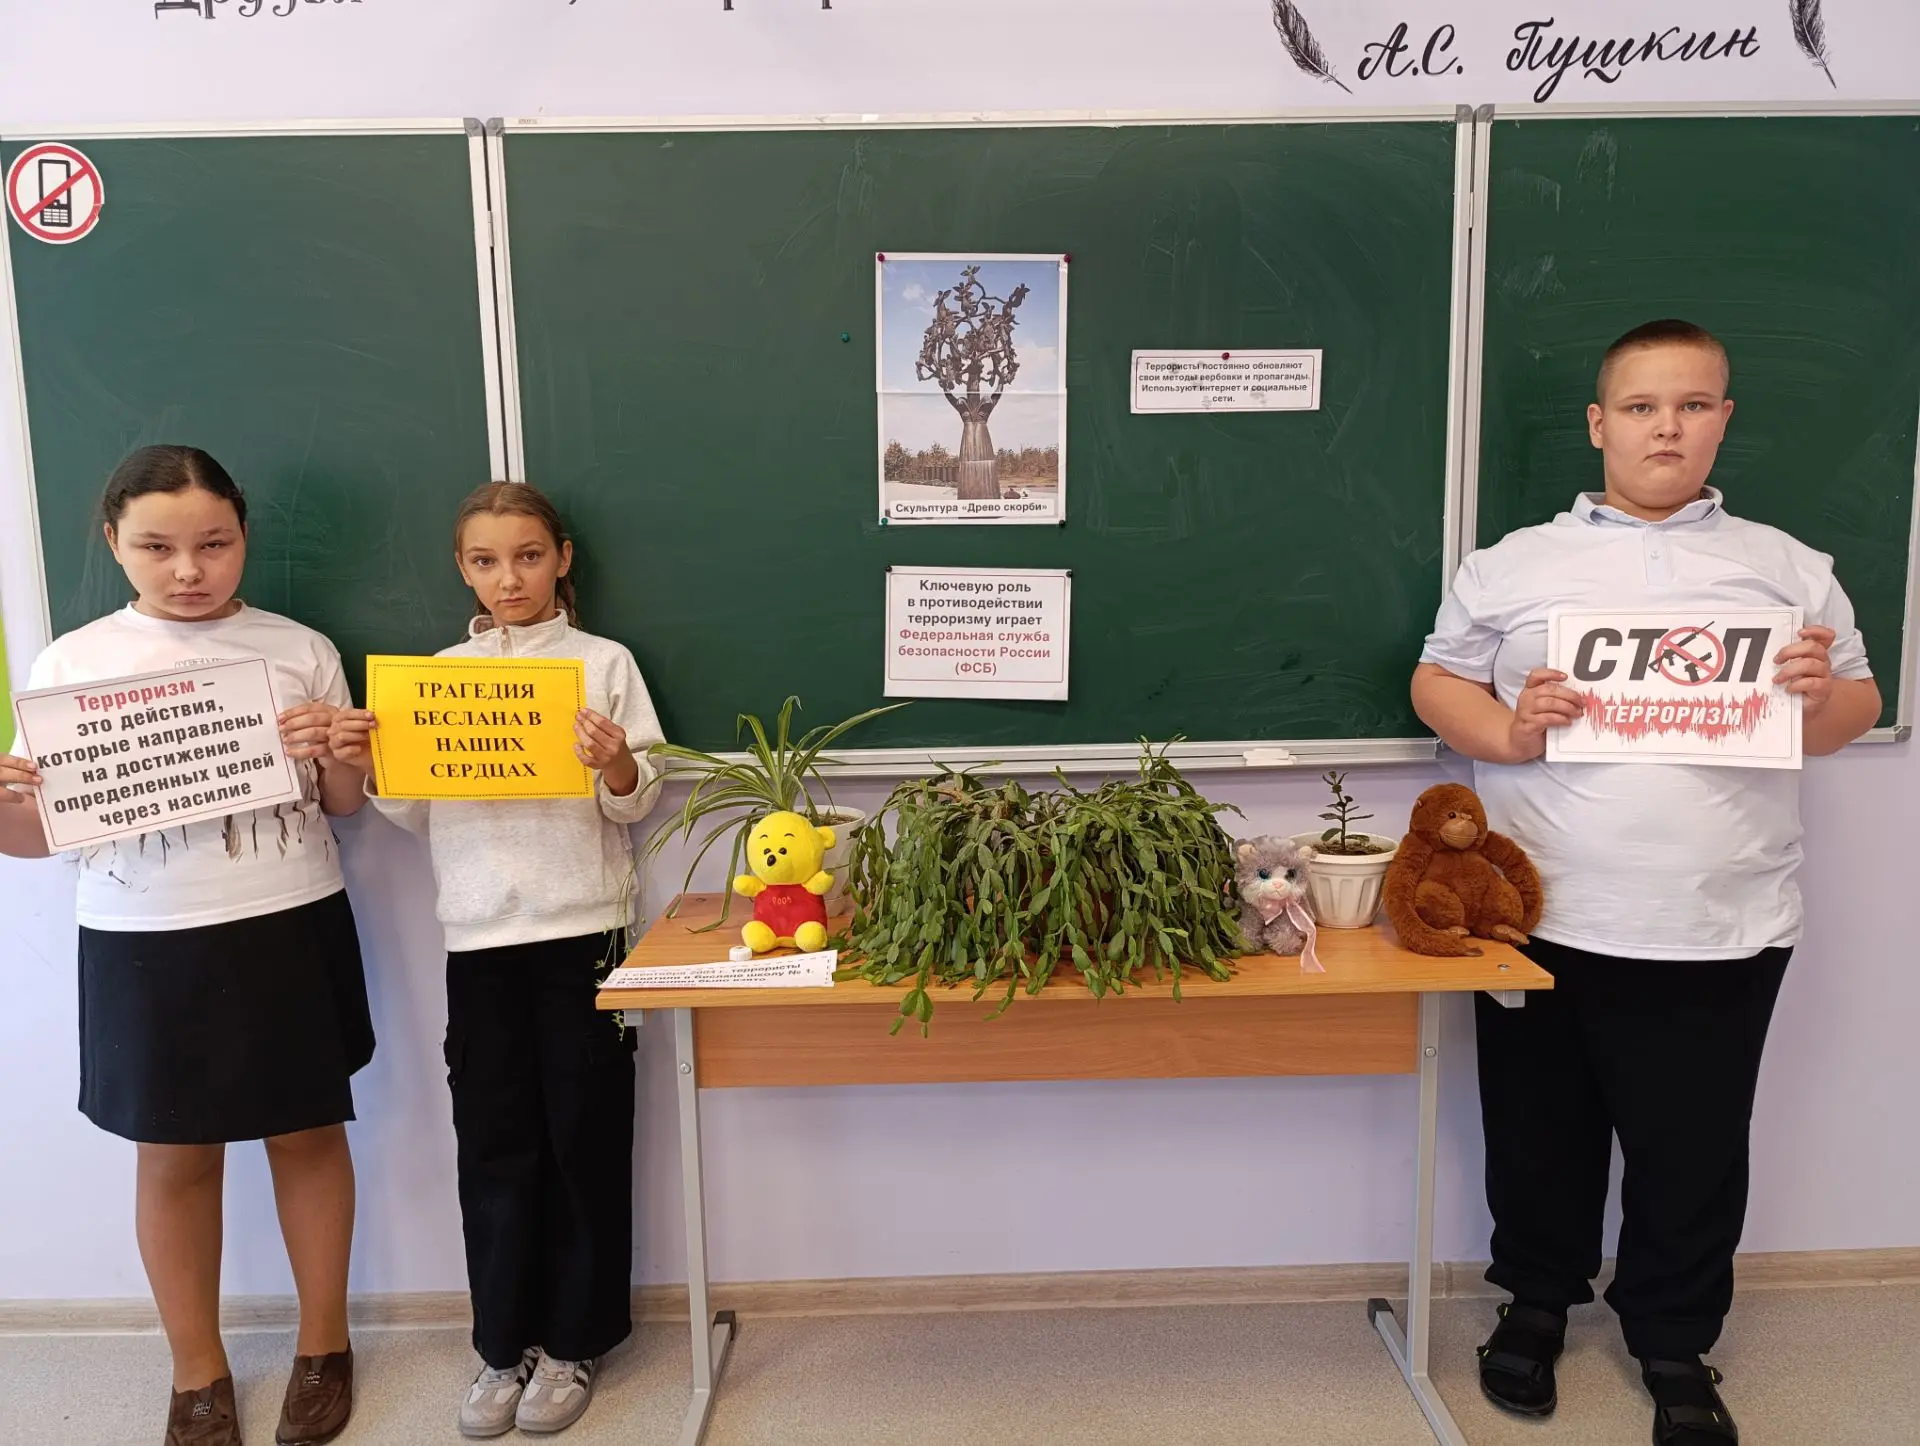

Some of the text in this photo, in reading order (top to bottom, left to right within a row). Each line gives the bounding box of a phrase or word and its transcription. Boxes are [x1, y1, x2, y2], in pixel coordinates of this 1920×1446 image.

[1357, 16, 1761, 104] А.С. Пушкин
[1145, 362, 1303, 371] Террористы постоянно обновляют
[1162, 374, 1198, 382] методы
[1200, 373, 1242, 381] вербовки
[1252, 374, 1310, 382] пропаганды.
[1141, 384, 1197, 393] Используют
[1199, 384, 1241, 393] интернет
[1251, 384, 1307, 392] социальные
[895, 502, 1048, 513] Скульптура «Древо скорби»
[919, 580, 1031, 594] Ключевую роль
[908, 597, 1043, 609] в противодействии
[908, 614, 1042, 627] терроризму играет
[900, 629, 1050, 643] Федеральная служба
[898, 645, 1050, 658] безопасности России
[955, 662, 997, 675] (ФСБ)
[74, 679, 196, 712] Терроризм
[415, 682, 535, 701] ТРАГЕДИЯ
[77, 698, 224, 737] это действия,
[414, 711, 542, 726] БЕСЛАНА В
[1604, 705, 1743, 726] ТЕРРОРИЗМ
[37, 713, 263, 769] которые направлены
[437, 738, 526, 752] НАШИХ
[82, 739, 241, 784] на достижение
[430, 763, 537, 780] СЕРДЦАХ
[54, 753, 275, 813] определенных целей
[100, 781, 252, 827] через насилие
[732, 964, 801, 974] террористы
